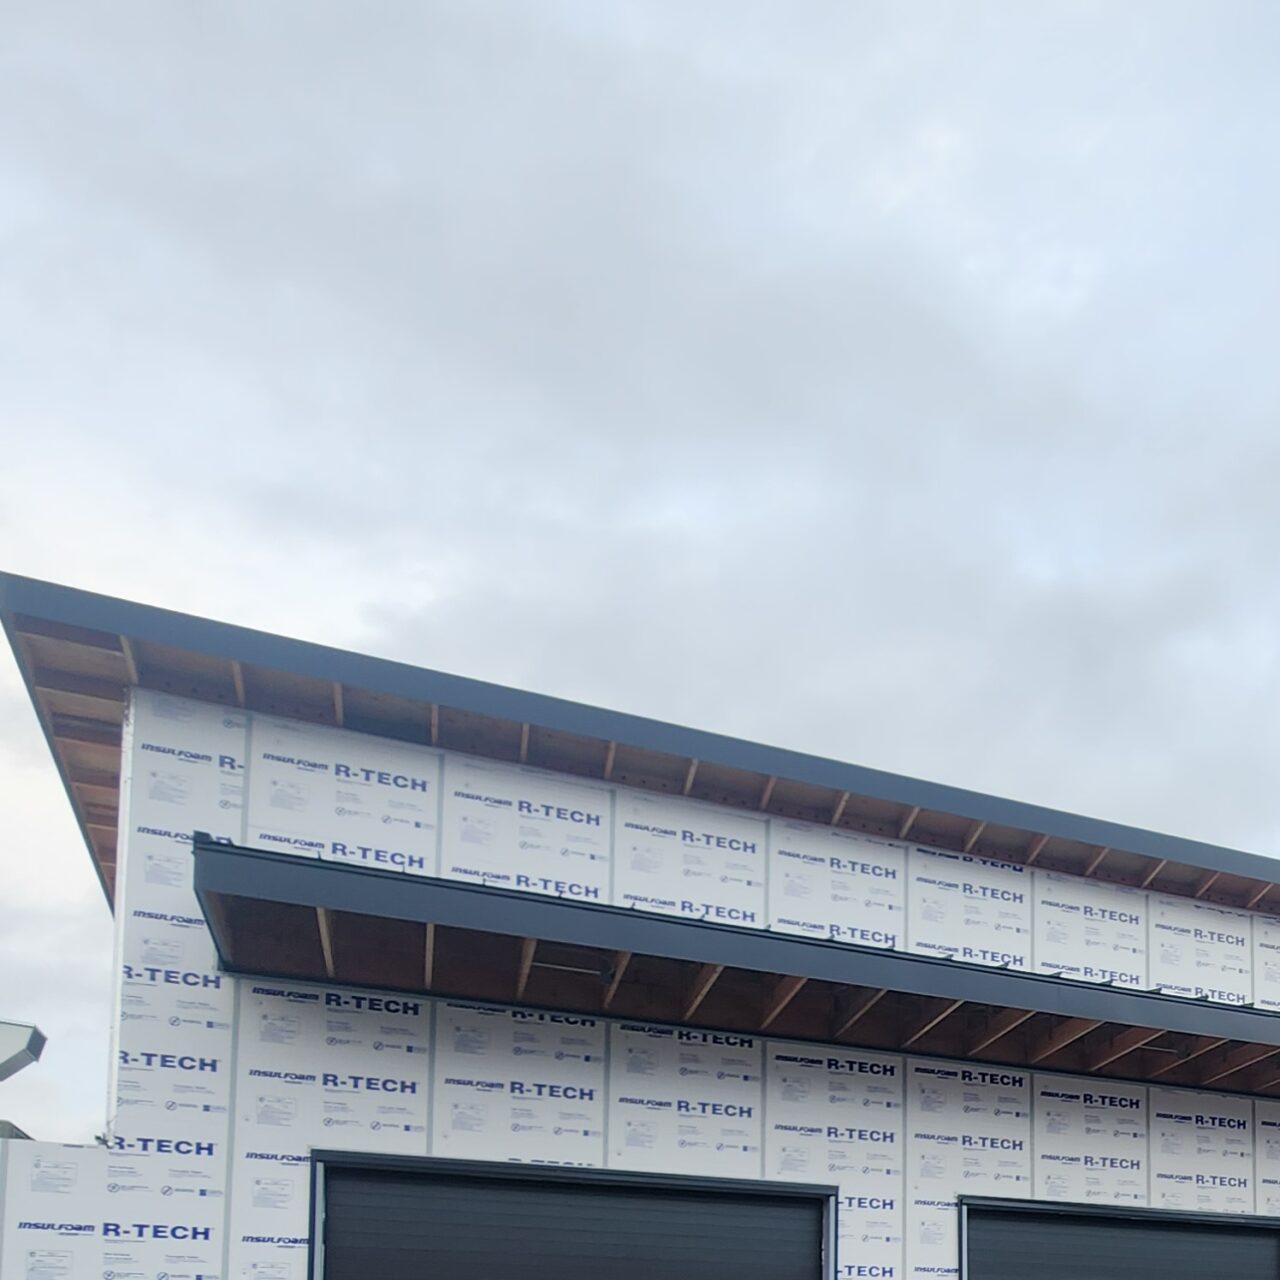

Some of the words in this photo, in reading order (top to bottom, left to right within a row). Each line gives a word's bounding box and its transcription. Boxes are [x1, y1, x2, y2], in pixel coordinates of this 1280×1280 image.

[335, 764, 427, 792] R-TECH
[518, 800, 600, 826] R-TECH
[682, 831, 756, 853] R-TECH
[331, 843, 425, 869] R-TECH
[830, 857, 897, 879] R-TECH
[516, 874, 598, 899] R-TECH
[963, 883, 1023, 904] R-TECH
[681, 900, 755, 923] R-TECH
[1084, 906, 1140, 925] R-TECH
[829, 924, 896, 944] R-TECH
[1194, 929, 1245, 947] R-TECH
[962, 946, 1023, 966] R-TECH
[1084, 966, 1140, 985] R-TECH
[325, 993, 419, 1015] R-TECH
[677, 1029, 753, 1048] R-TECH
[826, 1058, 895, 1077] R-TECH
[322, 1074, 417, 1094] R-TECH
[961, 1070, 1023, 1087] R-TECH
[509, 1082, 594, 1100] R-TECH
[676, 1100, 752, 1118] R-TECH
[1083, 1093, 1140, 1109] R-TECH
[1195, 1115, 1246, 1129] R-TECH
[826, 1126, 895, 1143] R-TECH
[961, 1135, 1023, 1150] R-TECH
[1084, 1156, 1140, 1169] R-TECH
[1196, 1175, 1247, 1187] R-TECH
[103, 1222, 210, 1241] R-TECH
